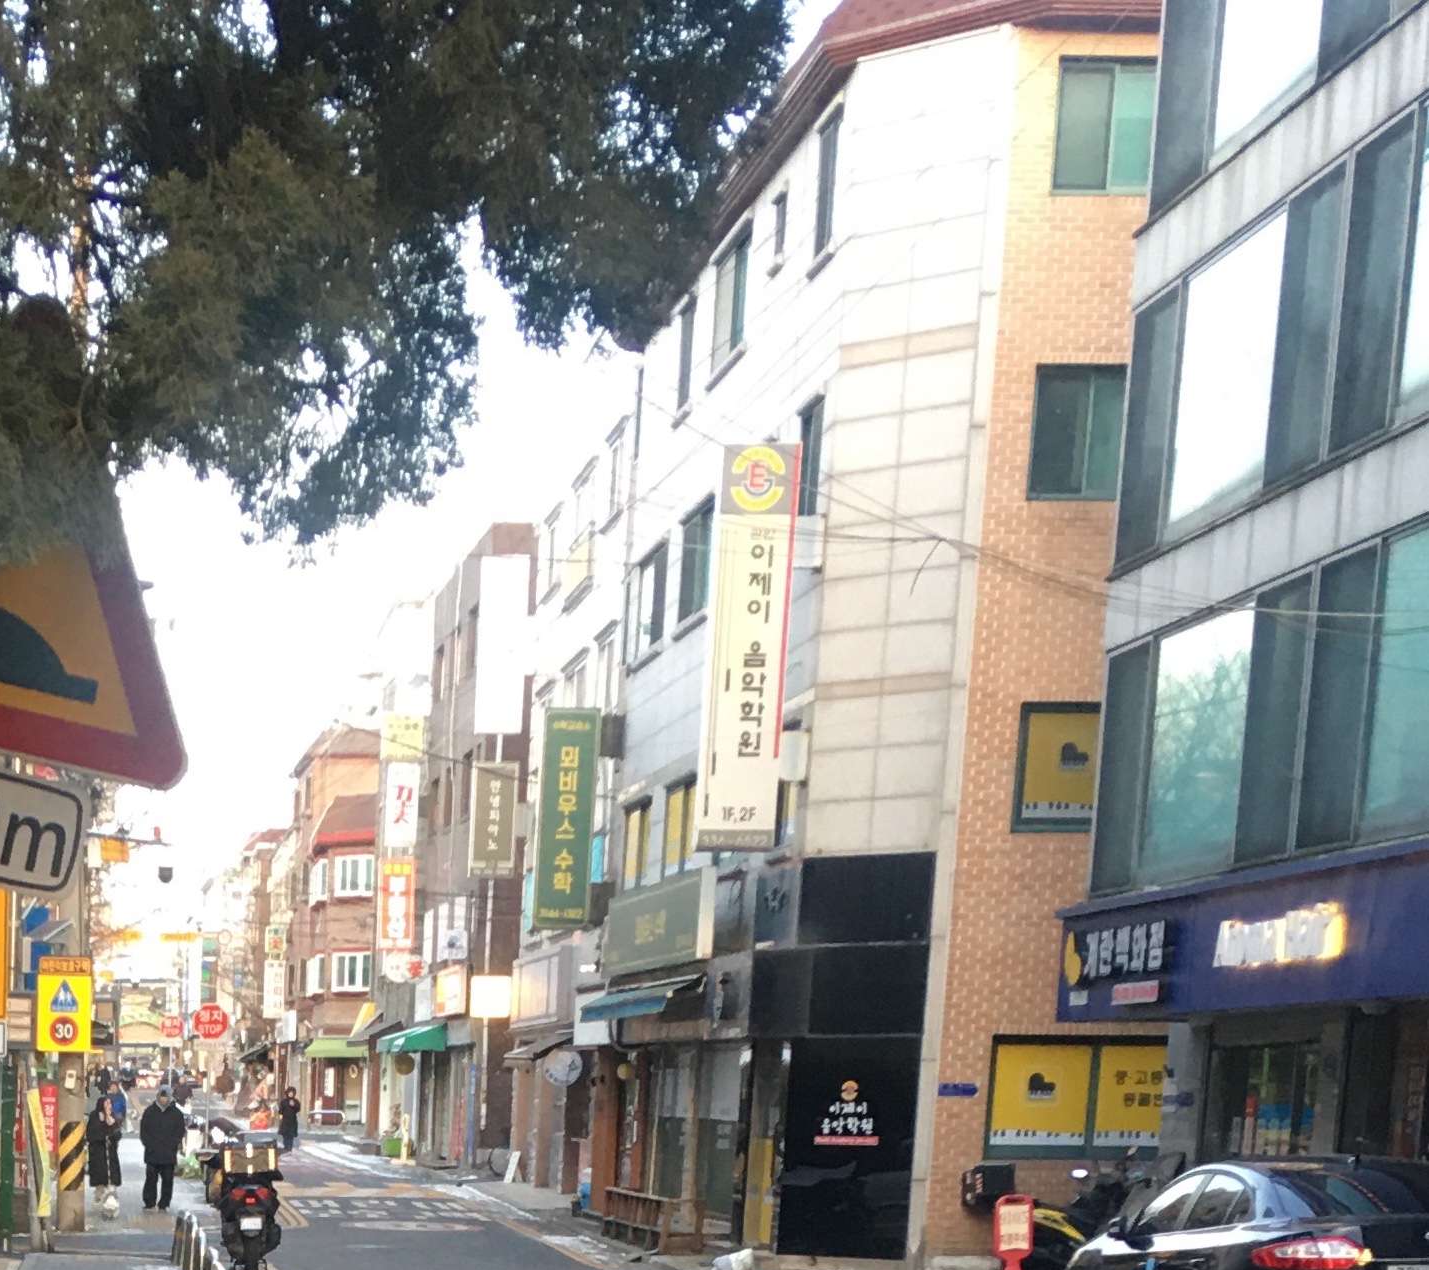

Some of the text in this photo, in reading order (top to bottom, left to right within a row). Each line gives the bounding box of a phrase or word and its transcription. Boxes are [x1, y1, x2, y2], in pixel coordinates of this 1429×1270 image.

[737, 543, 774, 758] 이제이 음악학원
[553, 847, 574, 895] 수학
[54, 1023, 74, 1039] 30
[198, 1023, 223, 1035] STOP
[829, 1101, 868, 1115] 이제이
[821, 1116, 874, 1135] 음악학원
